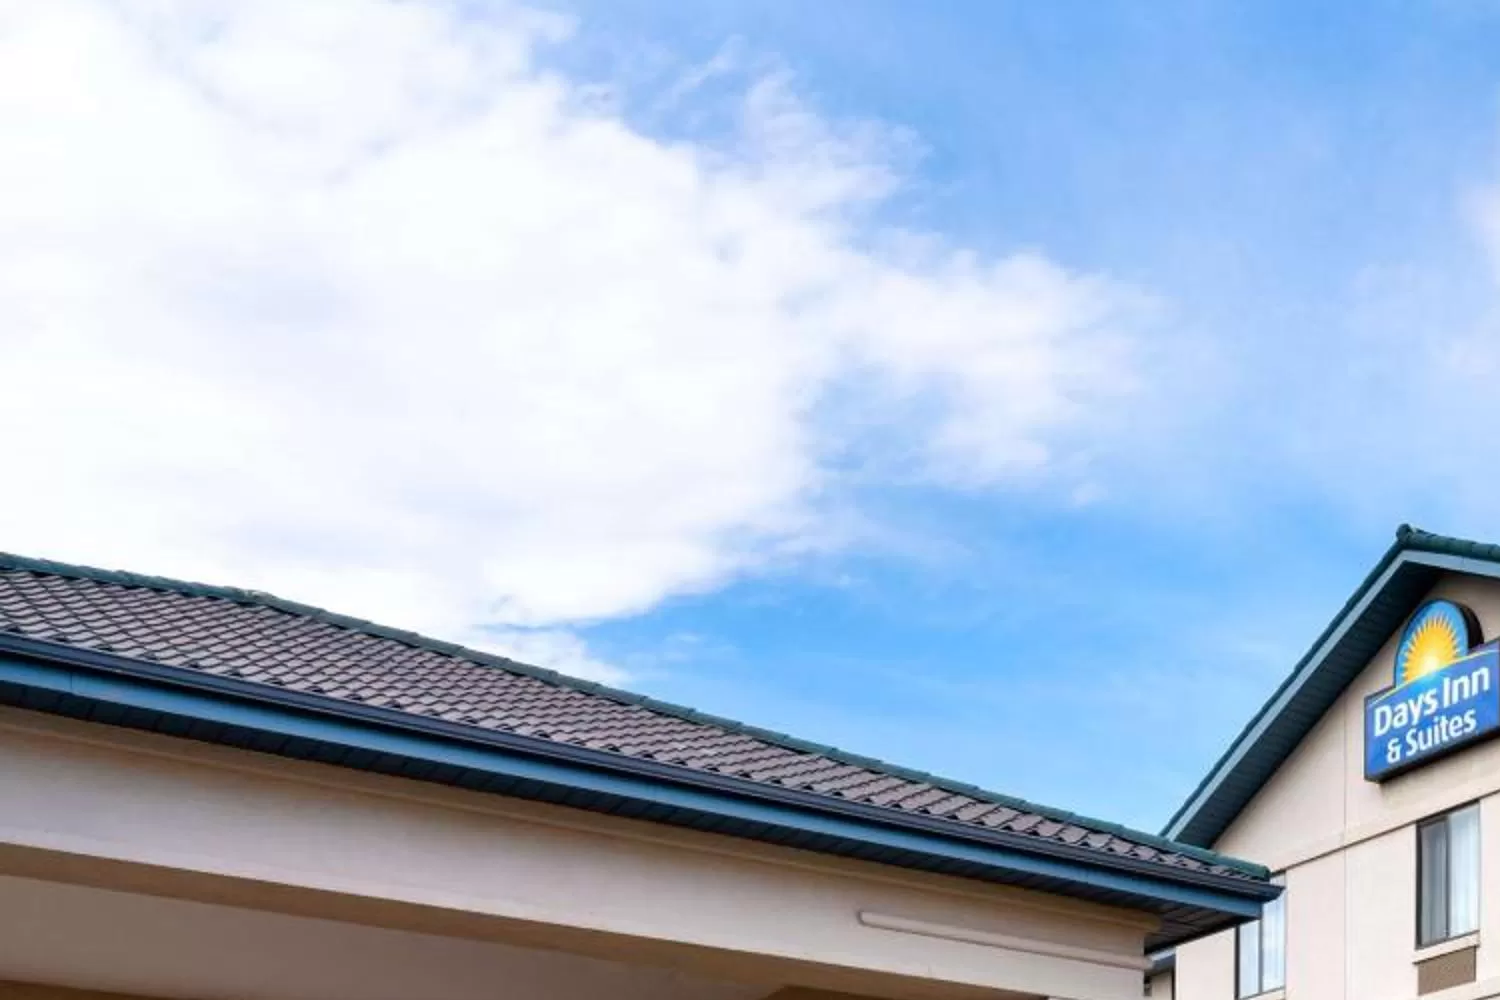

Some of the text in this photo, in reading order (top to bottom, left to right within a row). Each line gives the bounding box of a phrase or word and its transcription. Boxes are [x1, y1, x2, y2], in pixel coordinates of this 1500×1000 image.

[1374, 666, 1489, 737] Days Inn
[1387, 709, 1477, 763] & Suites
